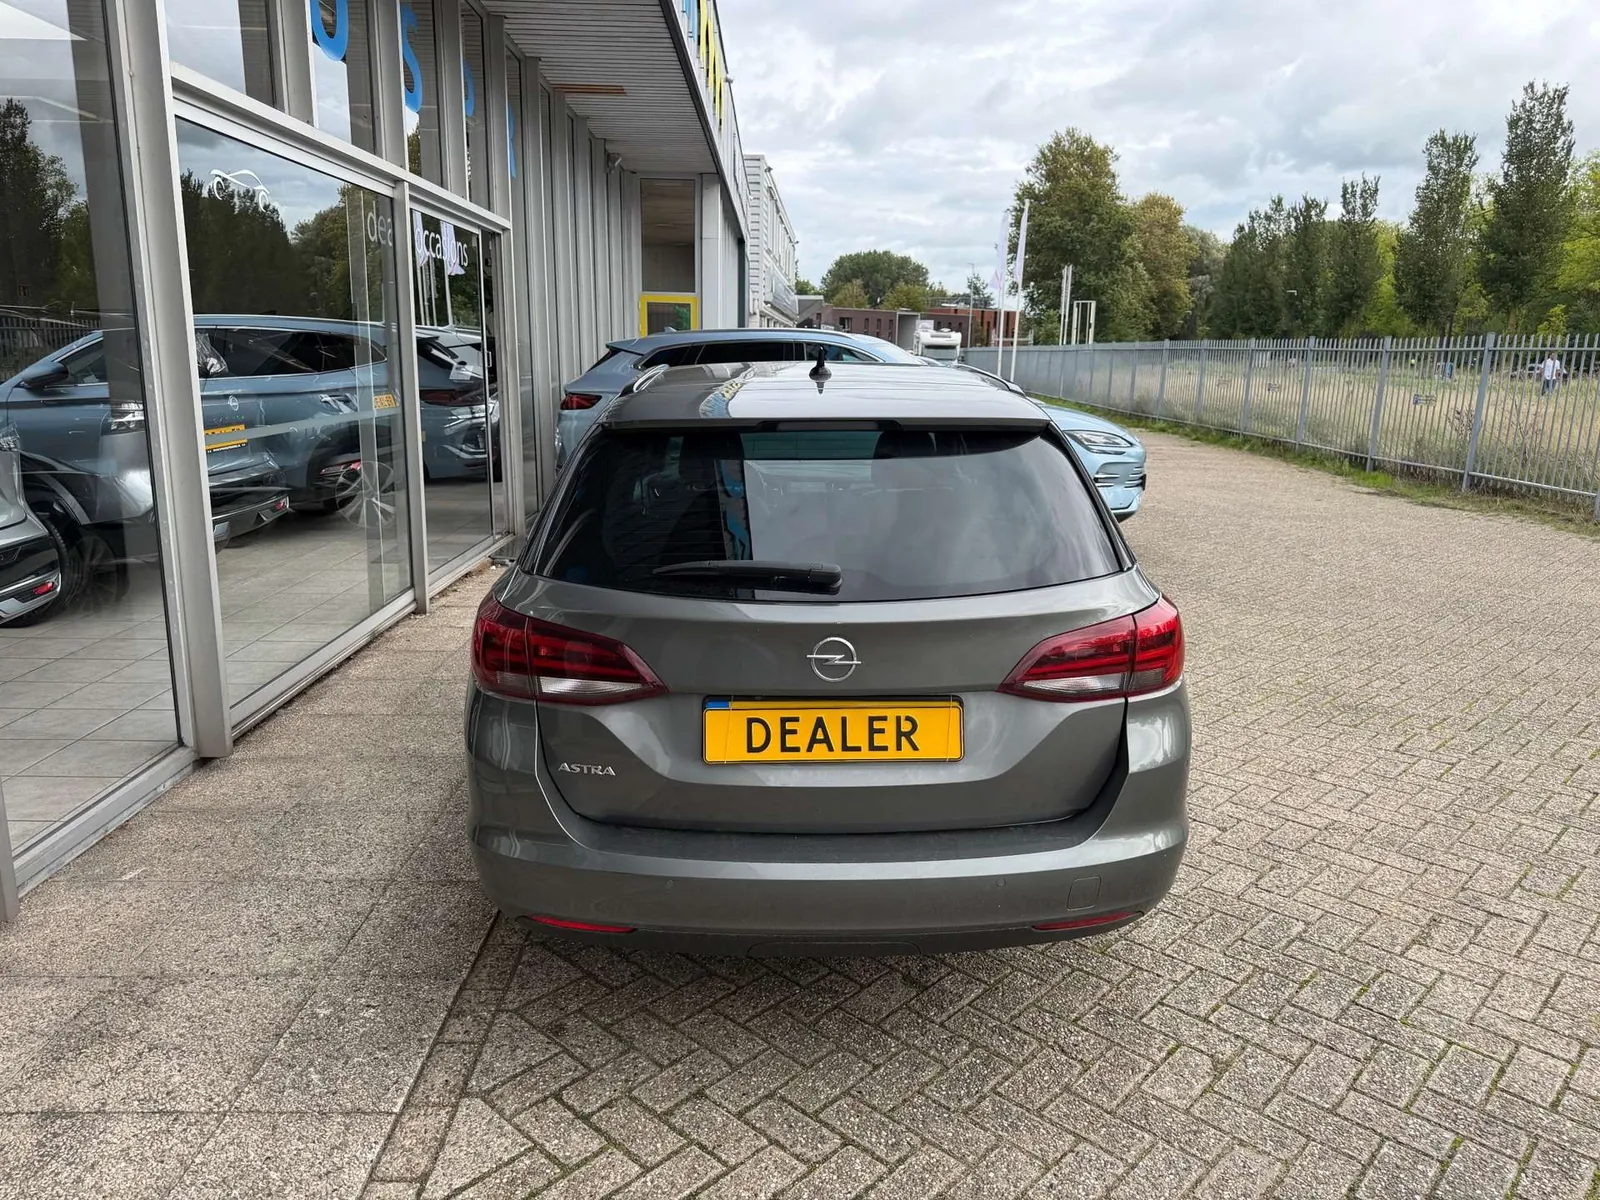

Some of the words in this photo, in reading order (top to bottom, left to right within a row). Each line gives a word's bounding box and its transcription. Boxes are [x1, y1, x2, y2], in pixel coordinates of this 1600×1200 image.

[415, 227, 468, 267] occasions
[746, 715, 920, 754] DEALER
[558, 762, 616, 776] ASTRA
